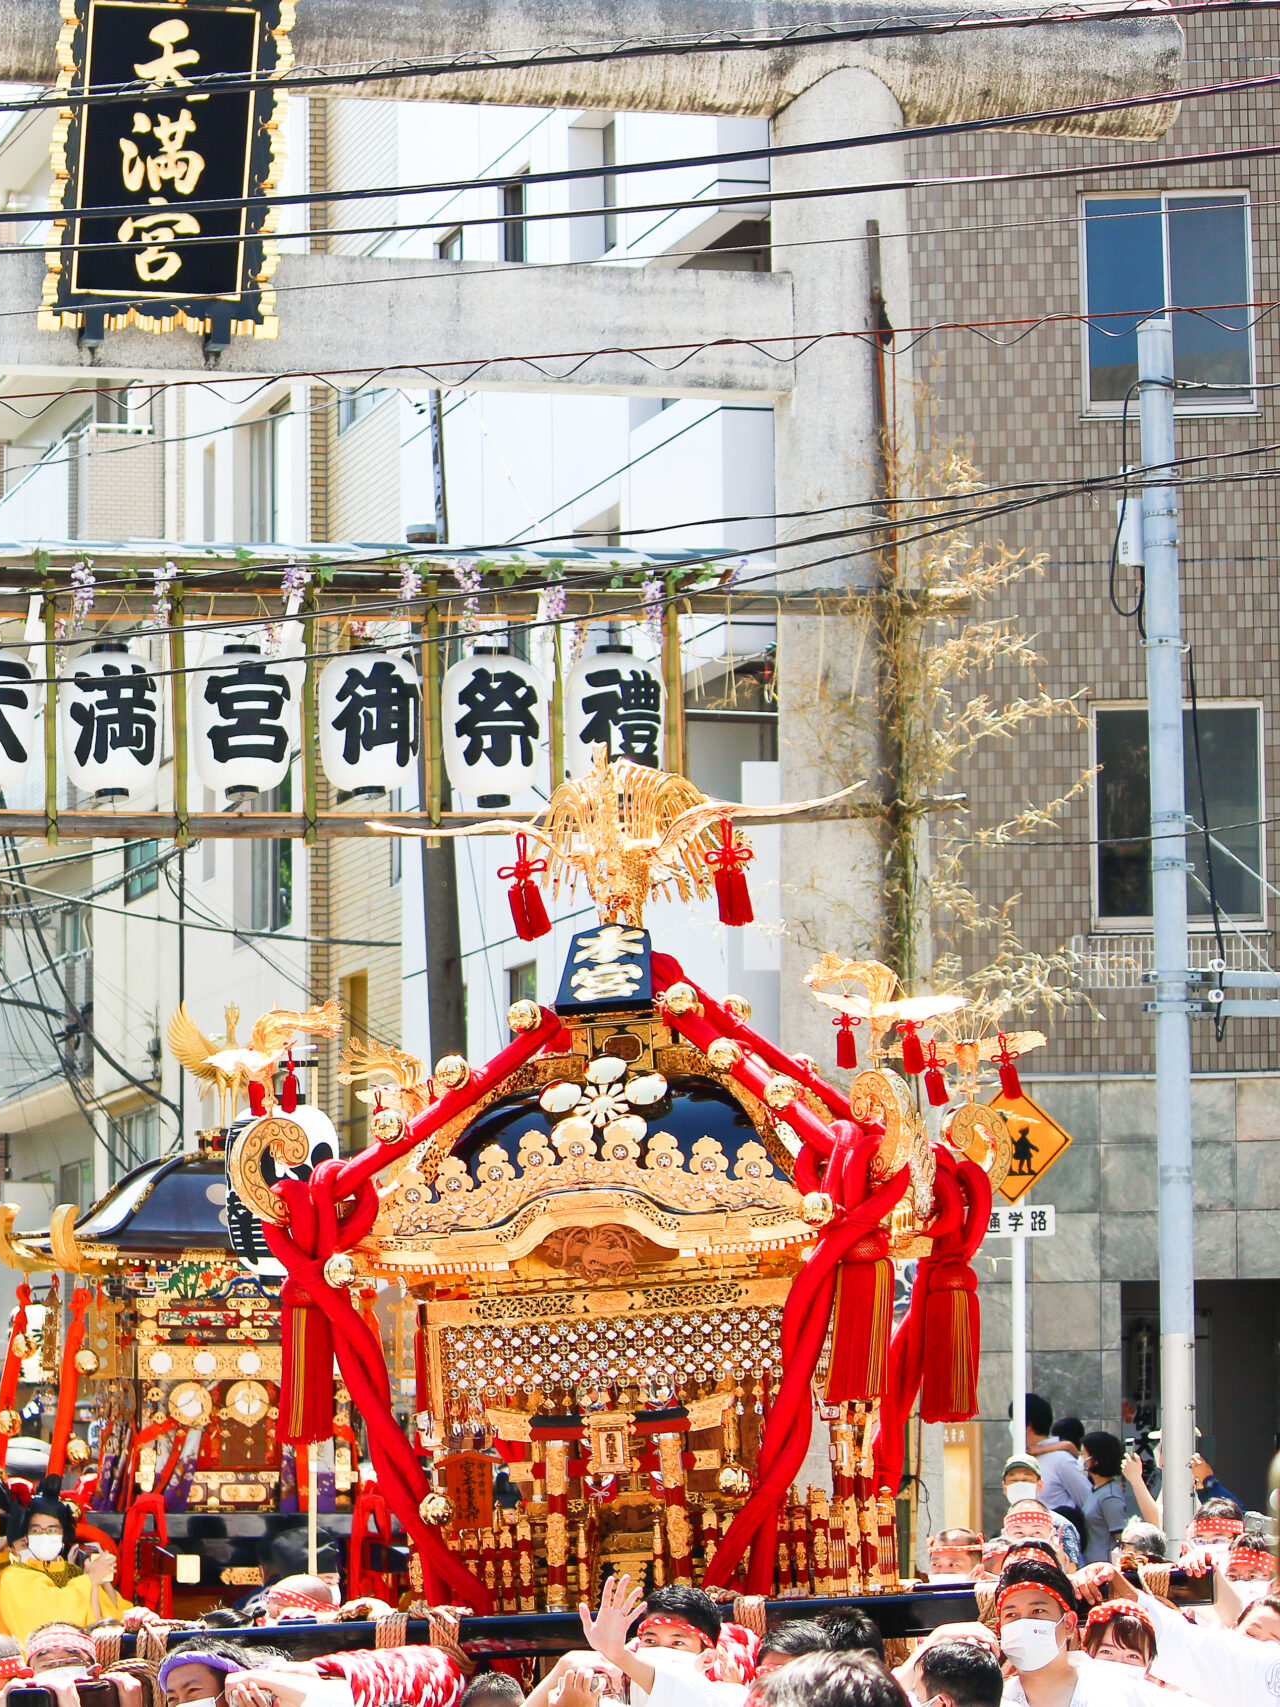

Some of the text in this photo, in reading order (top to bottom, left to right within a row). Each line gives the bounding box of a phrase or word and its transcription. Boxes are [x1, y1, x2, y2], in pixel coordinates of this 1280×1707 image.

[117, 18, 206, 282] 天満宮
[987, 1211, 1047, 1232] 通学路
